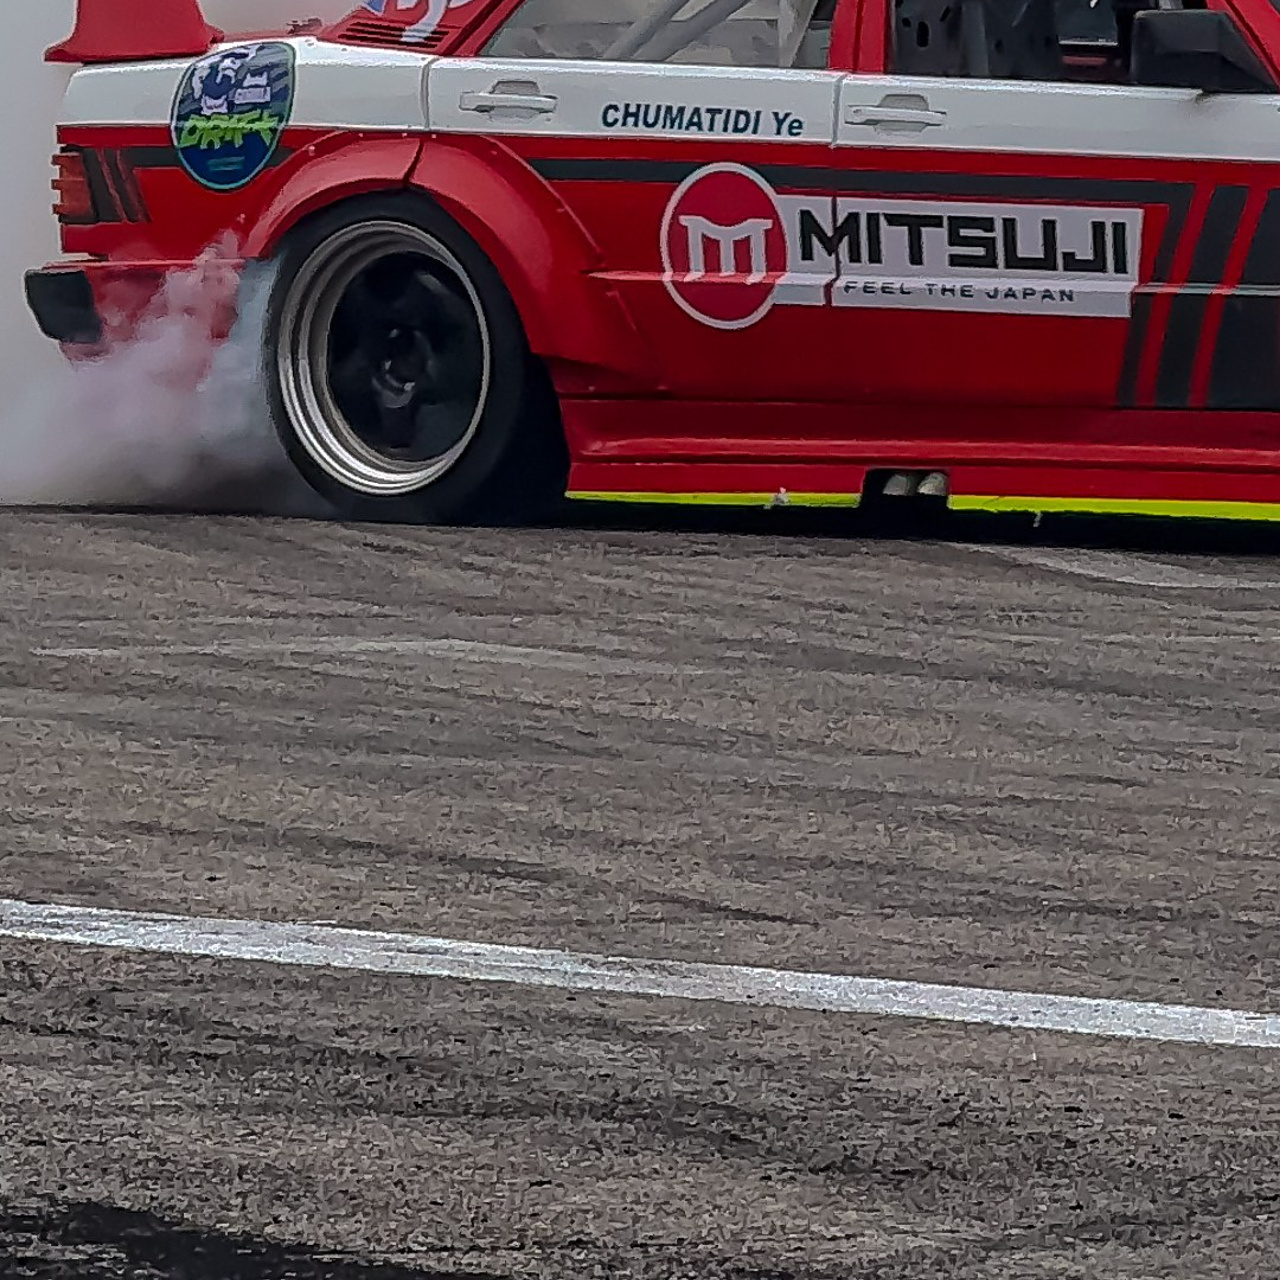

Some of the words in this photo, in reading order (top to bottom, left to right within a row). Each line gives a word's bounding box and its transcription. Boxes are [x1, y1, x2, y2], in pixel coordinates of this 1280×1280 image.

[602, 103, 761, 134] CHUMATIDI
[771, 111, 804, 136] Ye
[799, 208, 1128, 274] MITSUJI
[843, 281, 912, 295] FEEL
[925, 283, 974, 298] THE
[984, 286, 1075, 303] JAPAN
